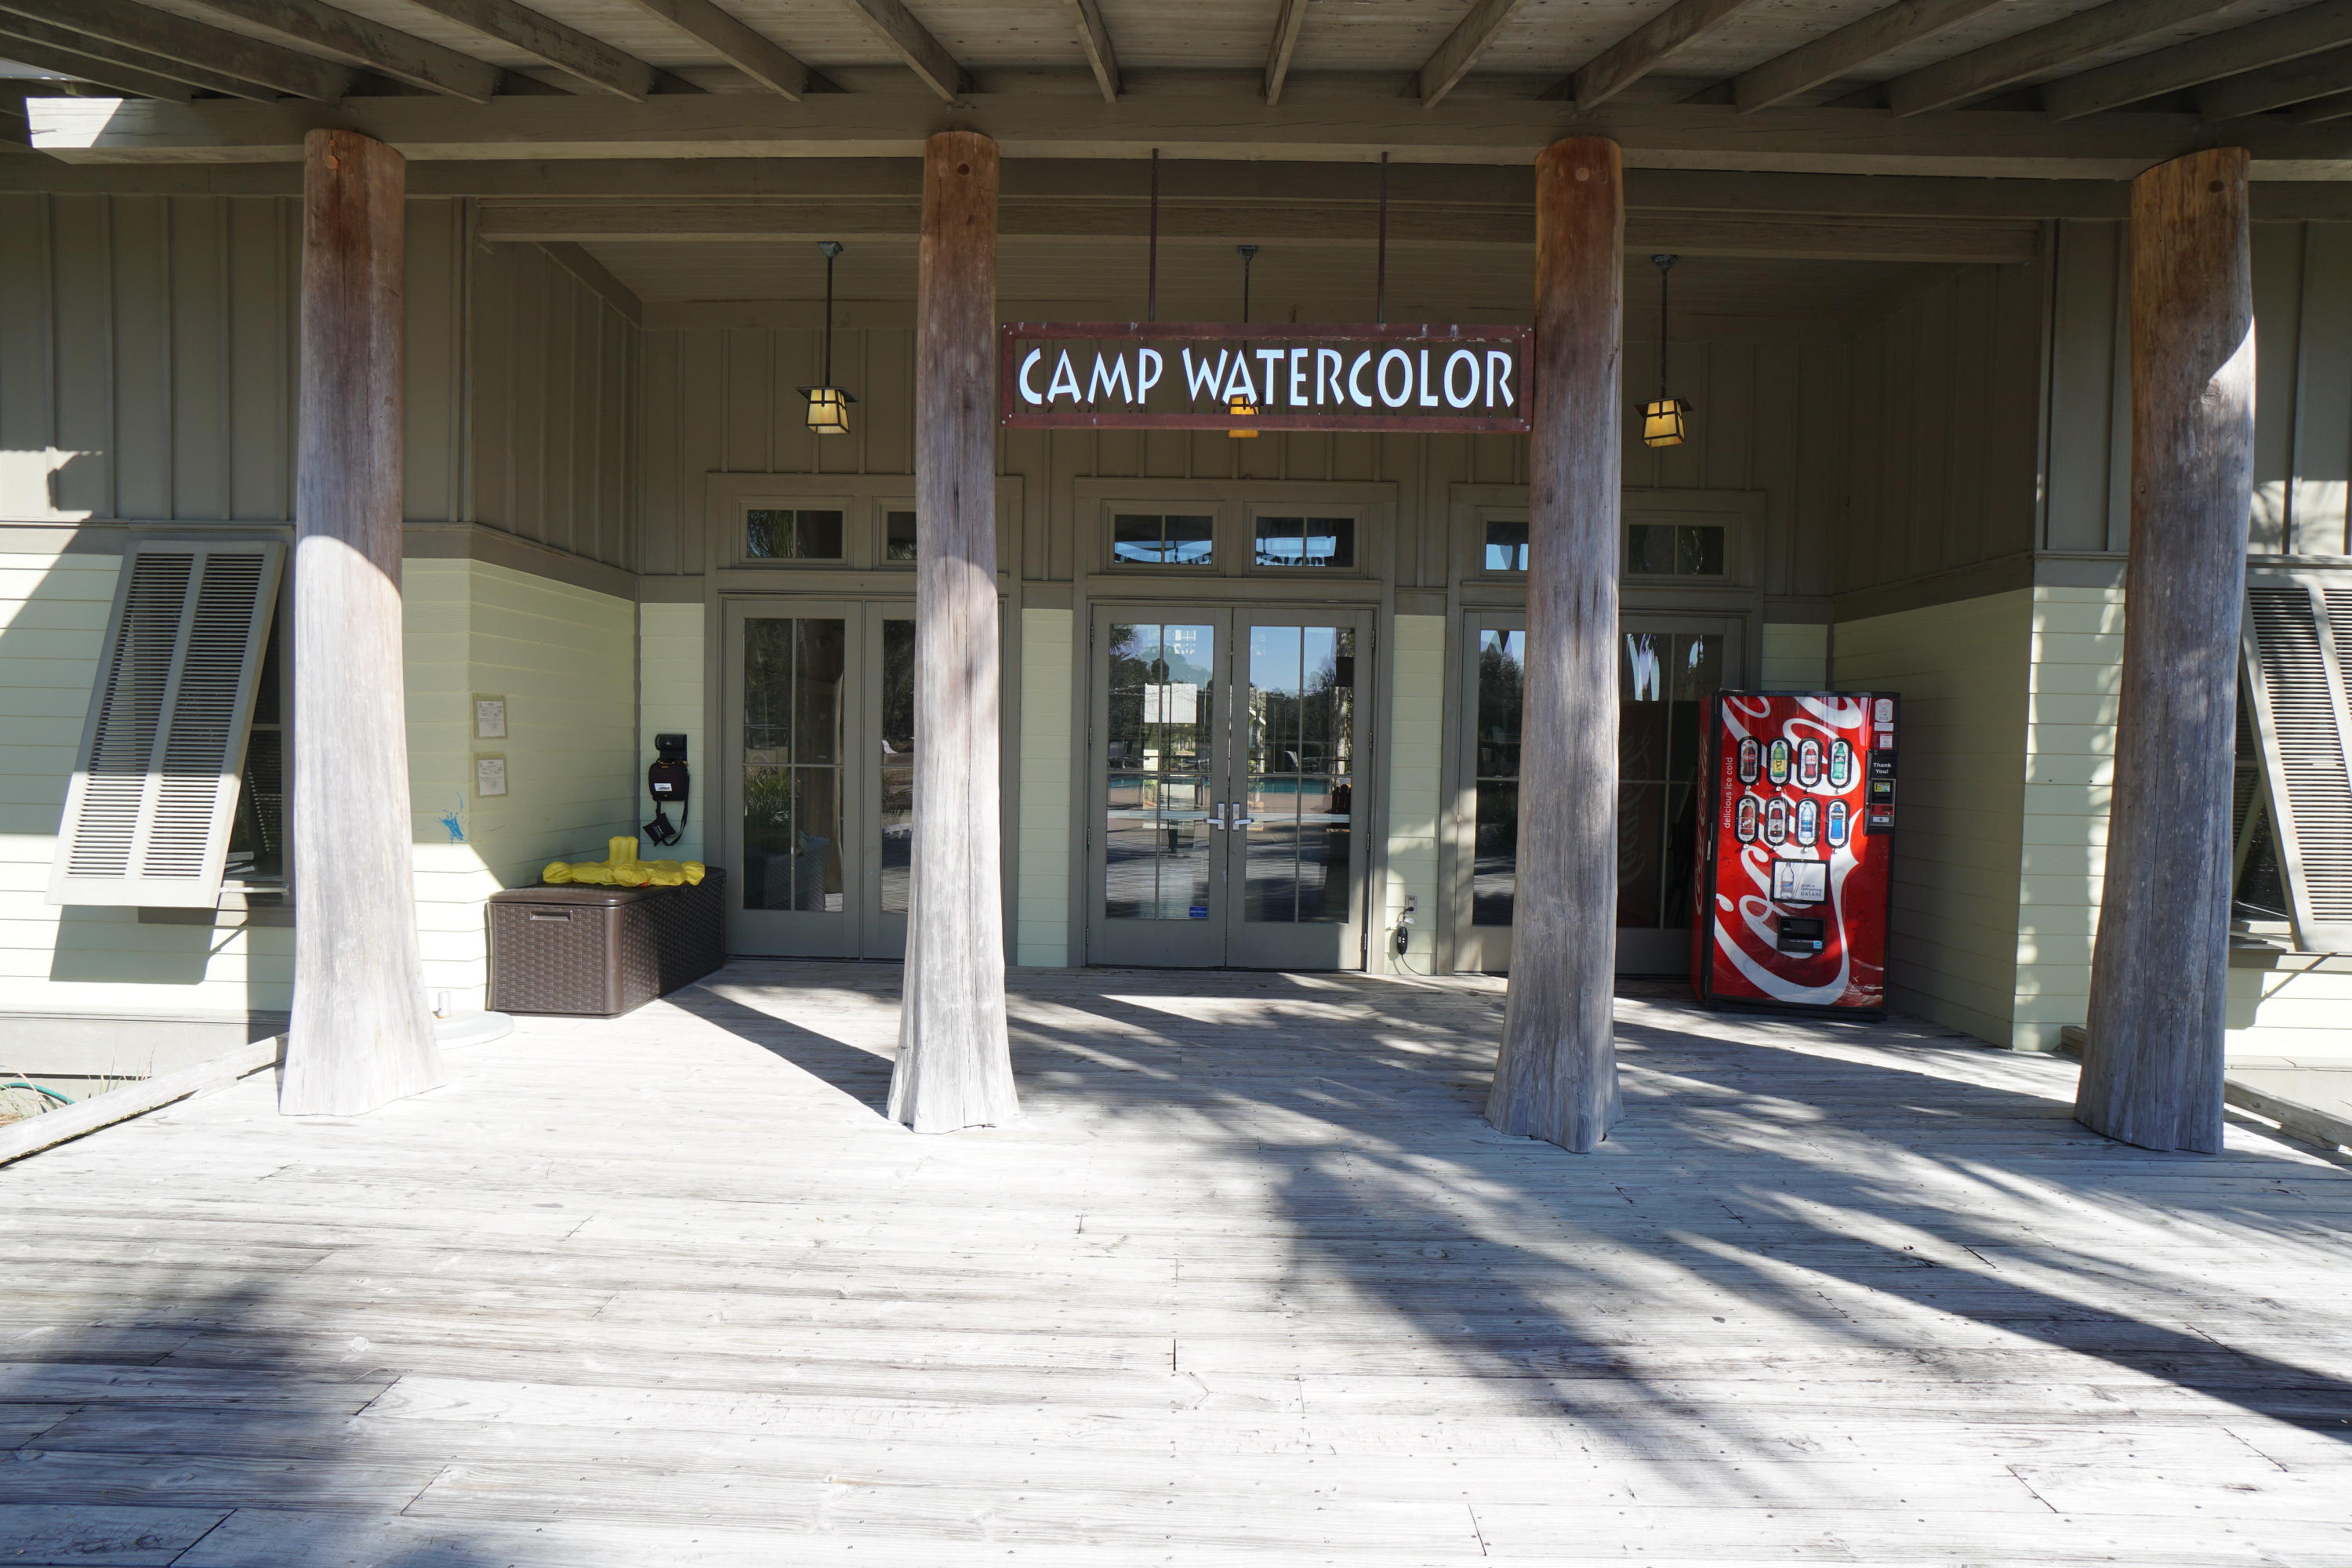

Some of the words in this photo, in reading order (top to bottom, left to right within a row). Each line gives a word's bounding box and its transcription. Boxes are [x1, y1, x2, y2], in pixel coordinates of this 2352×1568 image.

[1018, 347, 1163, 405] CAMP
[1181, 347, 1514, 408] WATERCOLOR
[1725, 757, 1733, 775] cold
[1724, 777, 1733, 789] ice
[1722, 792, 1732, 829] delicious
